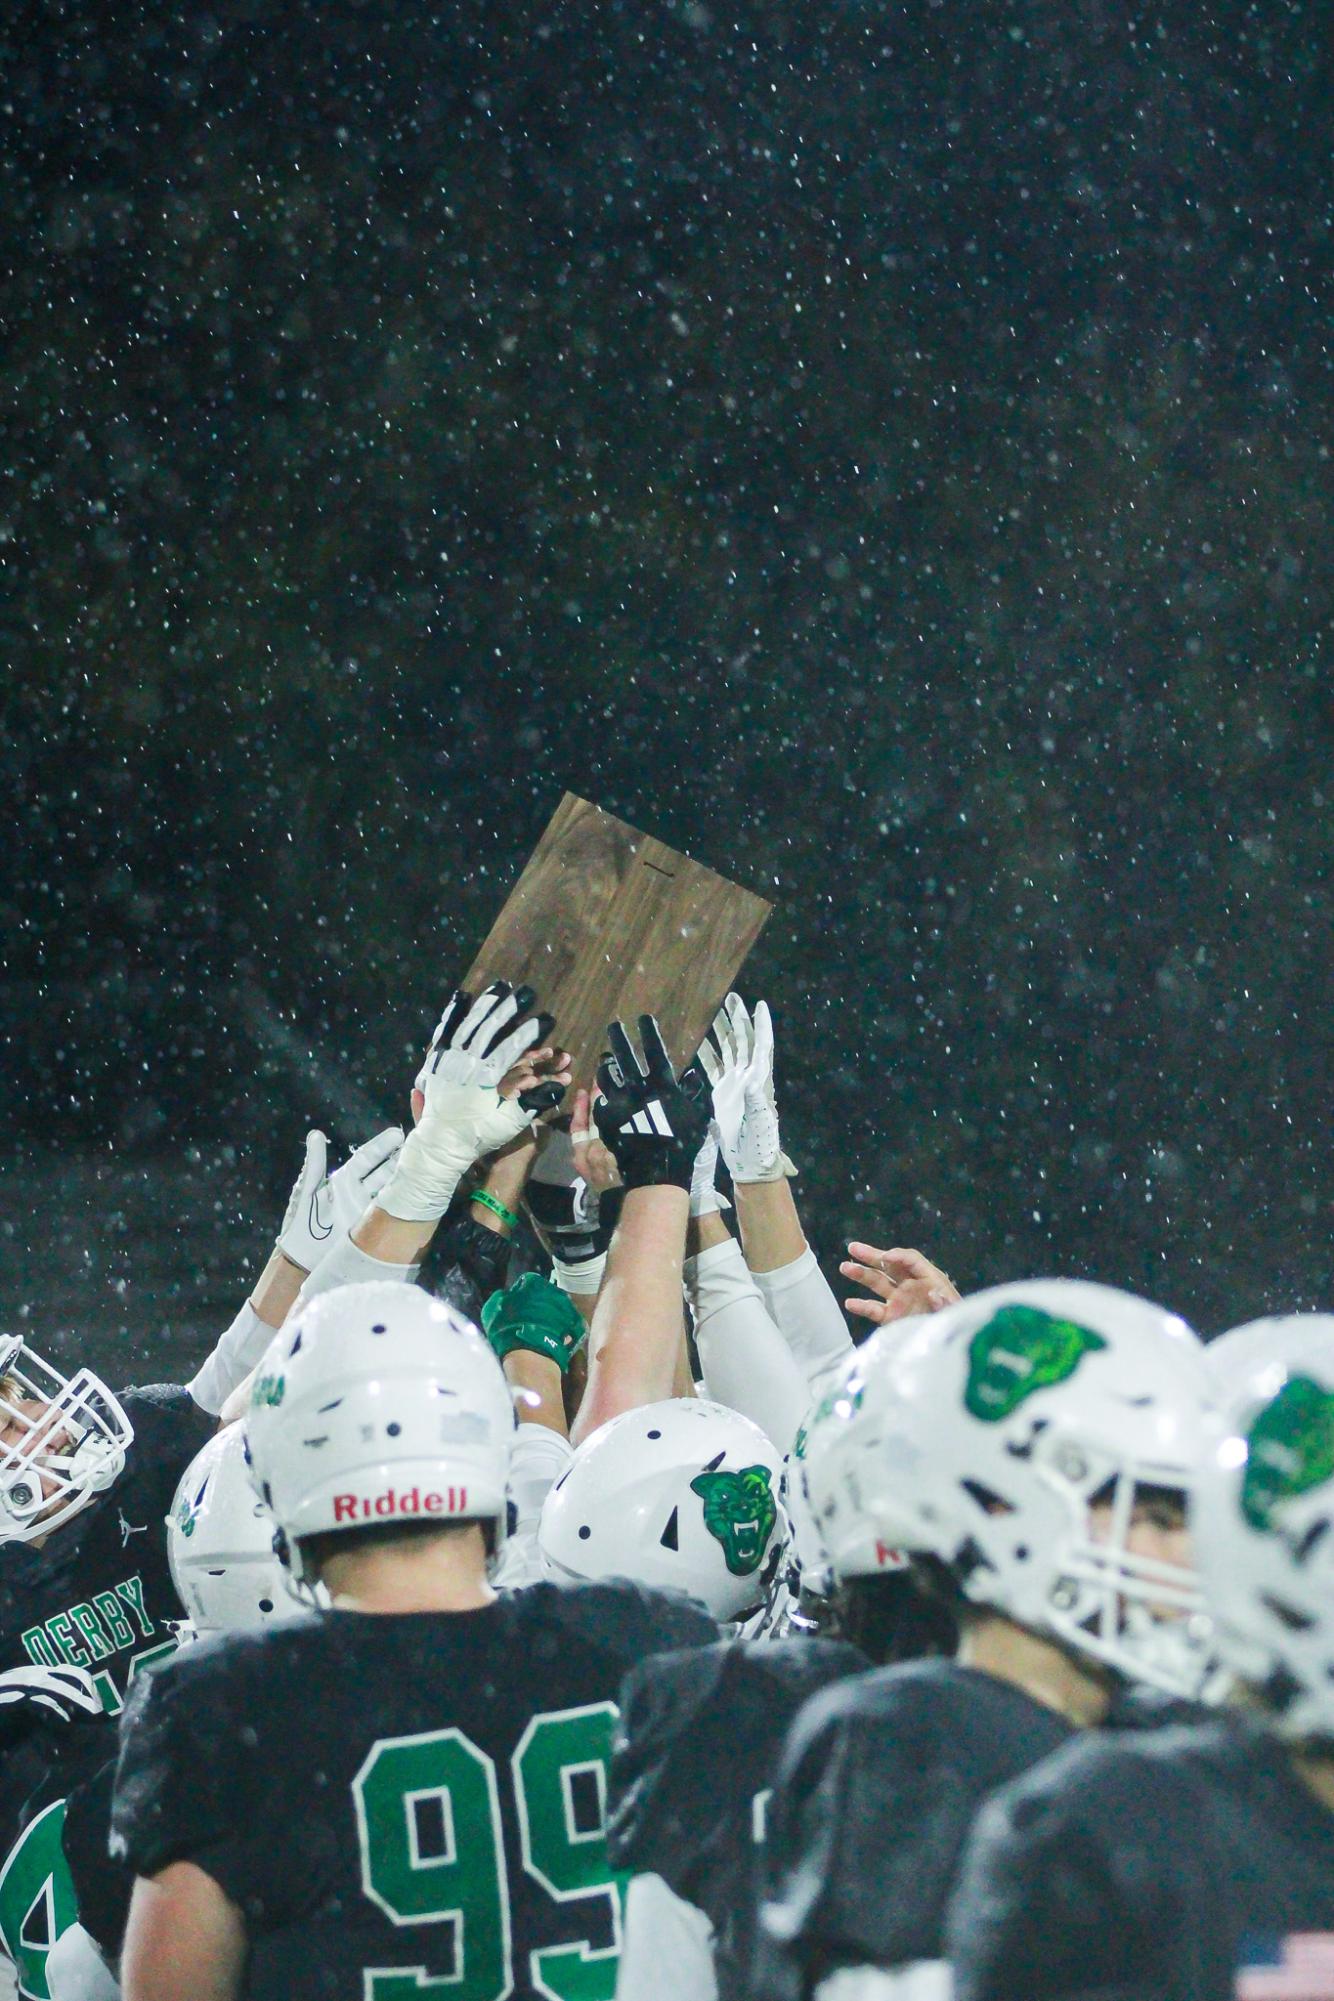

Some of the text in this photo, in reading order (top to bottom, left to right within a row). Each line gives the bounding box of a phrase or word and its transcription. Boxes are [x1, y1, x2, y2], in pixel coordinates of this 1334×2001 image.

[333, 1486, 467, 1521] Riddell
[21, 1575, 155, 1669] DERBY
[351, 1700, 629, 2001] 99
